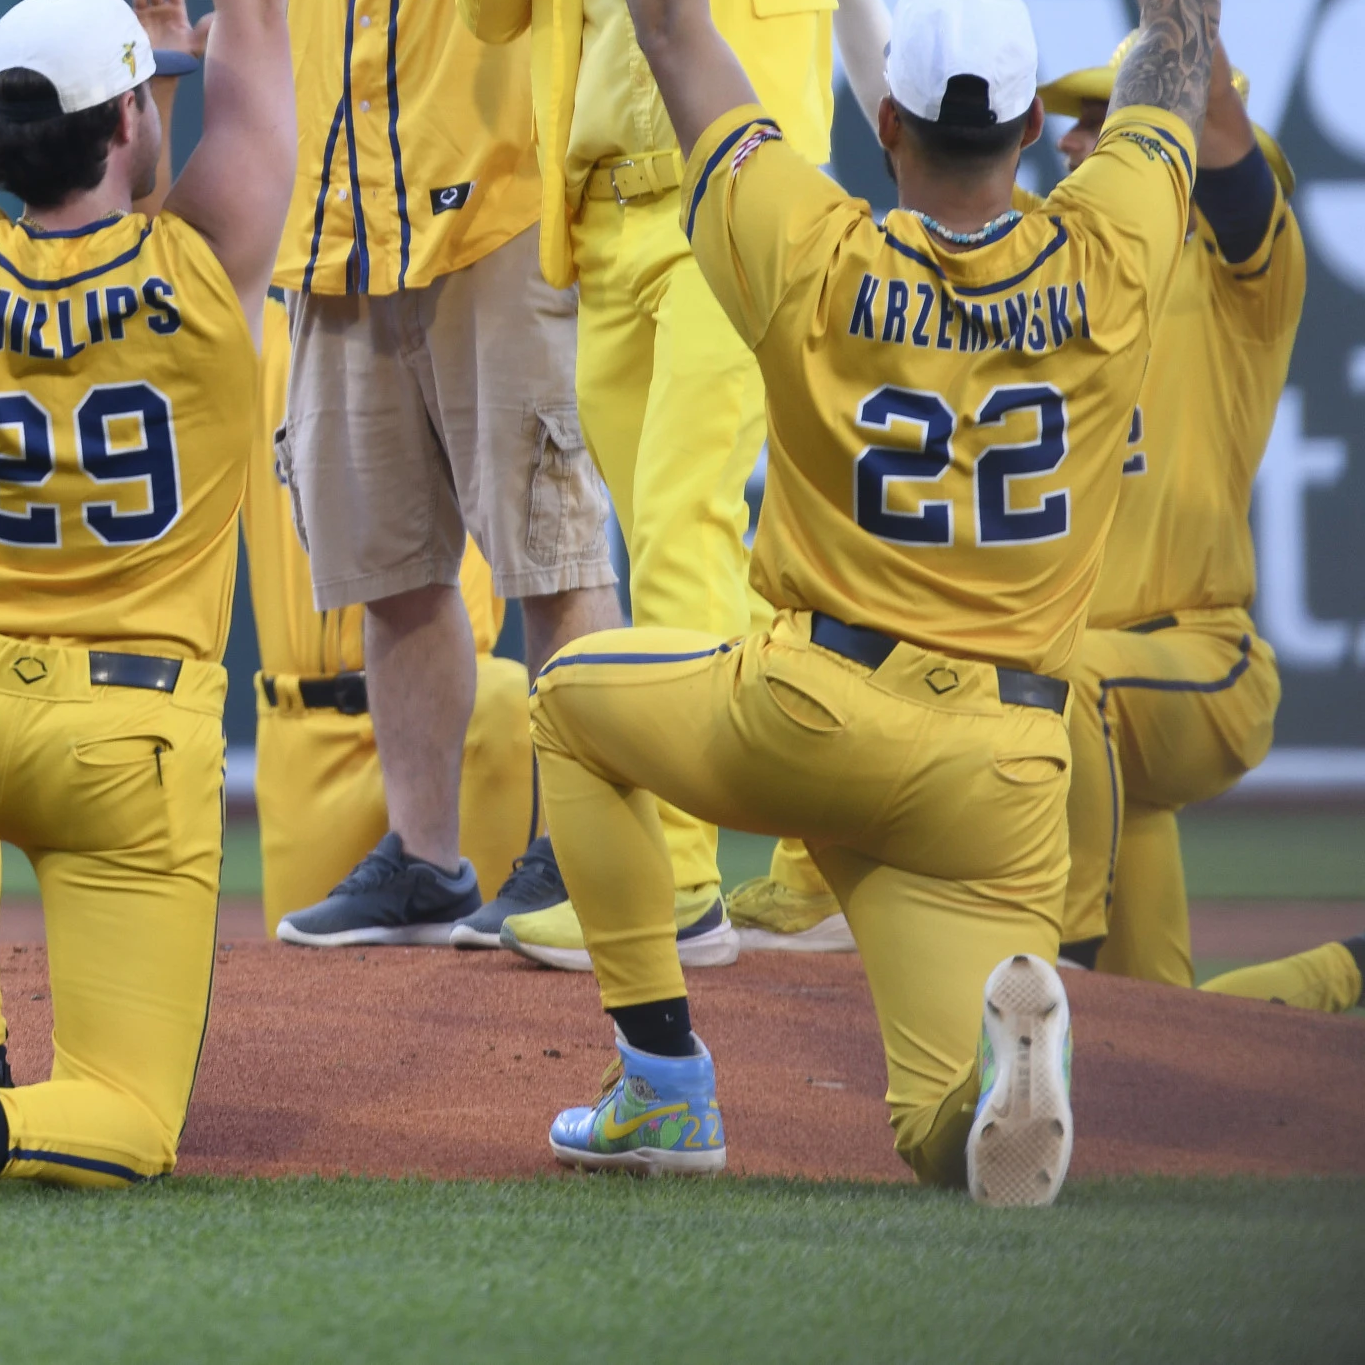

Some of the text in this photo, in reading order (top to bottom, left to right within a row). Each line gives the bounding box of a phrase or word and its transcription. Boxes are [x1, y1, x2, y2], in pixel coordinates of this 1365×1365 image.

[848, 271, 1092, 354] KRZEMINSKI
[852, 380, 1071, 549] 22
[682, 1113, 722, 1148] 22
